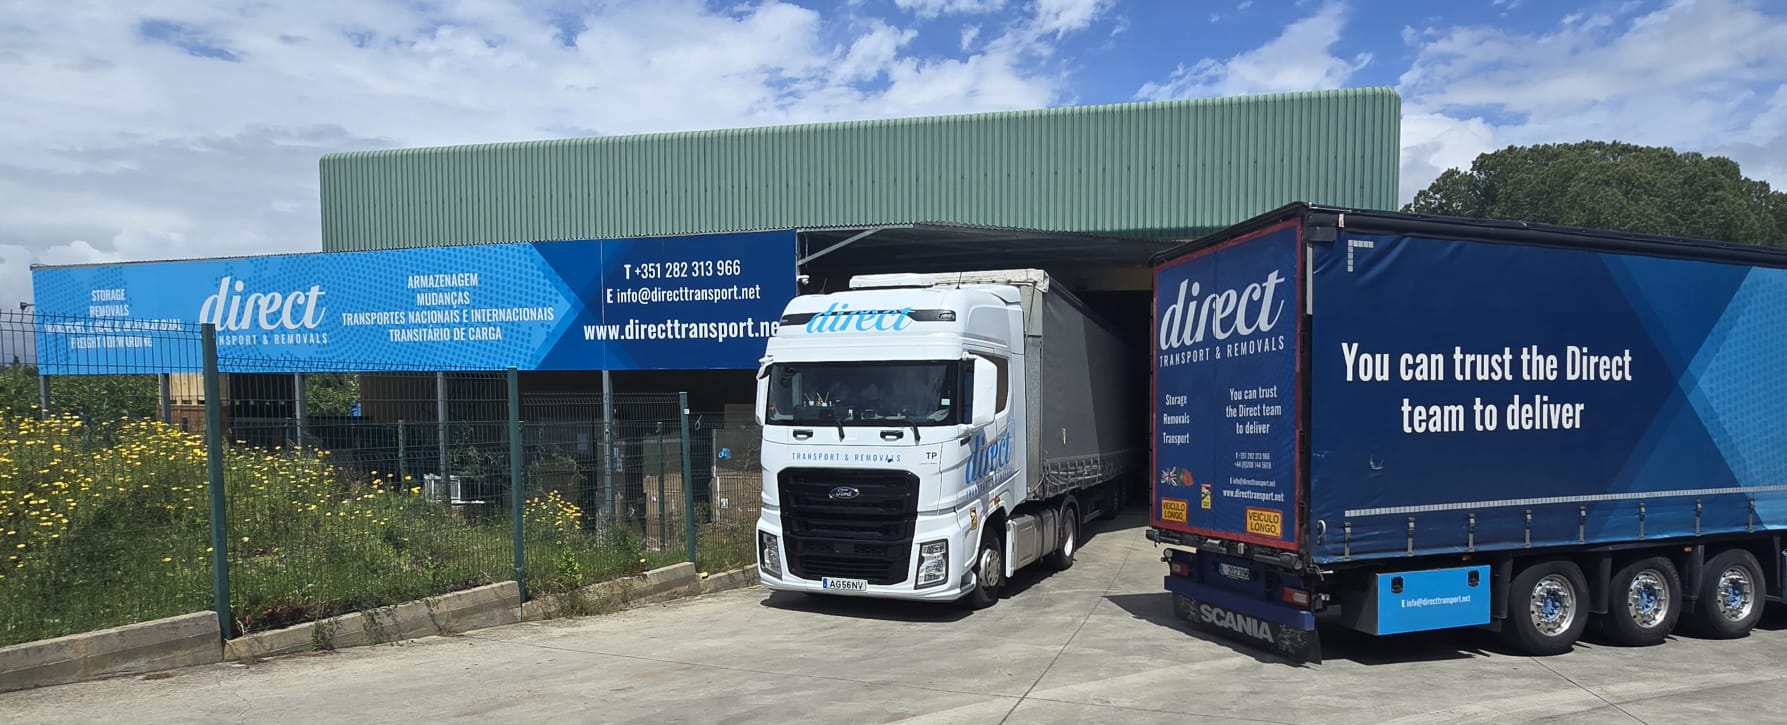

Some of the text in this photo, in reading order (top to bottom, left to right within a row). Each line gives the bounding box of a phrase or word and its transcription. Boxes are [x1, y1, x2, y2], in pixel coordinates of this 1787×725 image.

[624, 259, 741, 280] T +351 282 313 966
[408, 273, 478, 289] ARMAZENAGEM
[92, 289, 126, 301] STORAGE
[417, 291, 470, 308] MUDANÇAS
[607, 284, 761, 305] E info@directtransport.net
[90, 305, 129, 317] REMOVALS
[199, 276, 326, 331] direct
[1160, 269, 1286, 351] direct
[342, 307, 554, 326] TRANSPORTES NACIONAIS E INTERNACIONAIS
[806, 302, 916, 333] direct
[389, 325, 502, 342] TRANSITÁRIO DE CARGA
[584, 318, 779, 342] www.directtransport.ne
[216, 333, 328, 346] NSPORT & REMOVALS
[1160, 335, 1285, 368] TRANSPORT & REMOVALS
[1341, 342, 1632, 382] You can trust the Direct
[1165, 394, 1187, 407] Storage
[1230, 385, 1277, 401] You can trust
[1226, 403, 1282, 418] the Direct team
[1401, 395, 1584, 434] team to deliver
[1163, 412, 1190, 425] Removals
[1236, 421, 1270, 434] to deliver
[1163, 432, 1190, 446] Transport
[792, 452, 839, 461] TRANSPORT
[845, 453, 849, 461] &
[926, 452, 937, 460] TP
[1163, 501, 1185, 511] VEICULO
[1164, 510, 1184, 520] LONGO
[1249, 511, 1279, 524] VEICULO
[1250, 522, 1277, 534] LONGO
[830, 580, 863, 590] AG56NV
[1200, 604, 1275, 643] SCANIA
